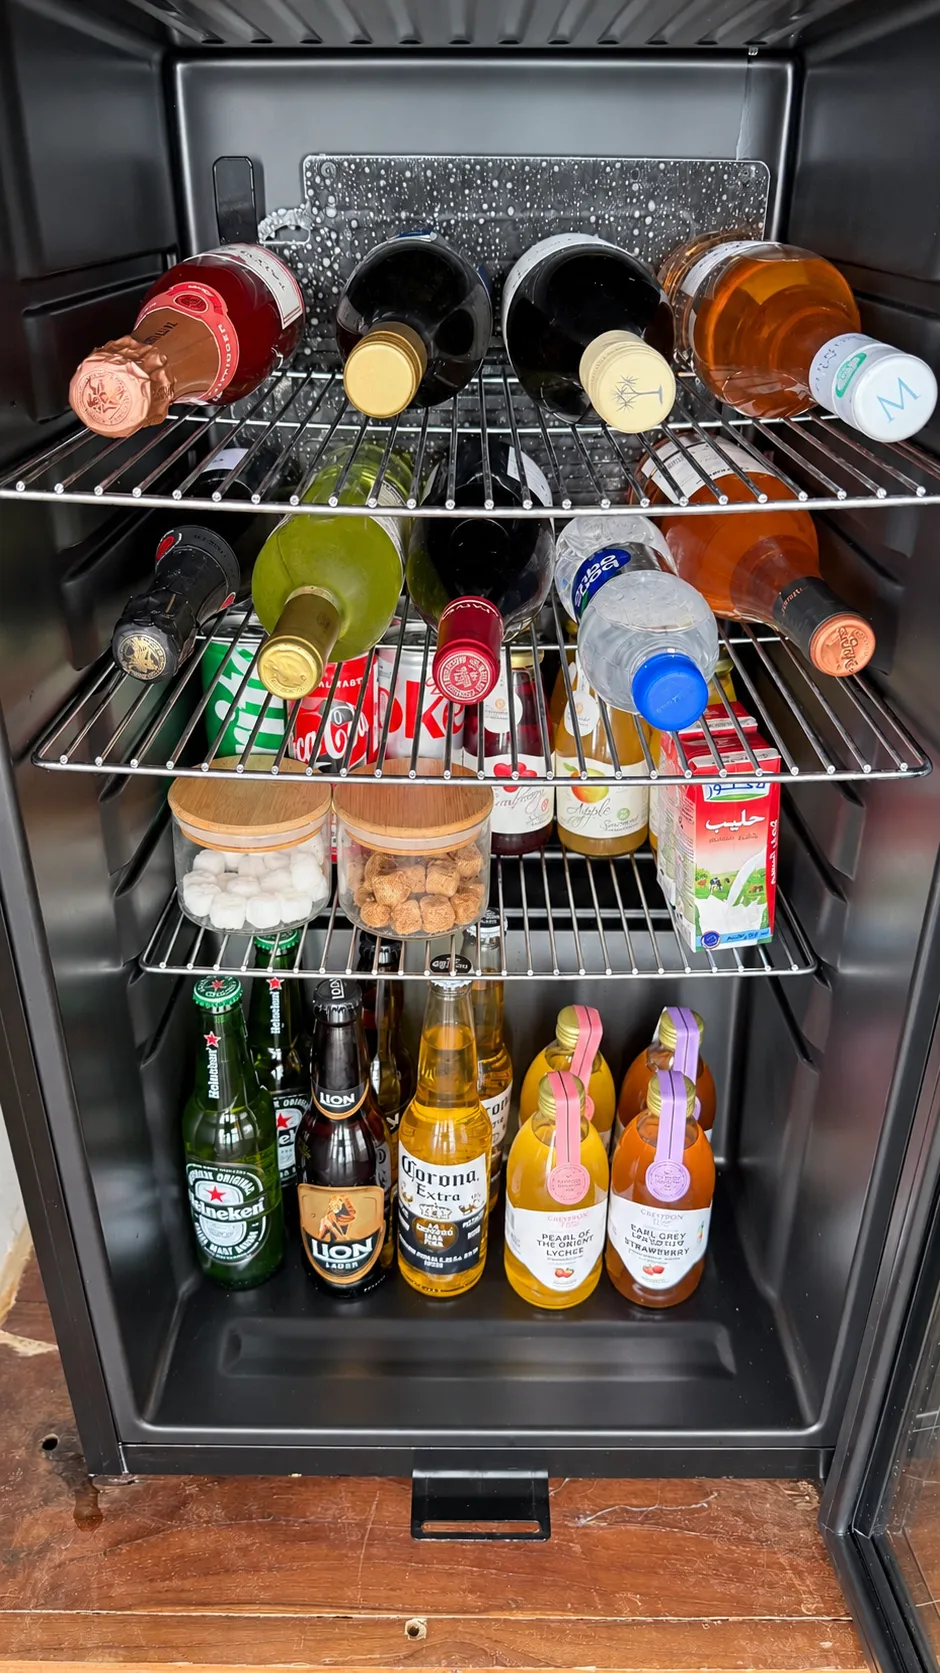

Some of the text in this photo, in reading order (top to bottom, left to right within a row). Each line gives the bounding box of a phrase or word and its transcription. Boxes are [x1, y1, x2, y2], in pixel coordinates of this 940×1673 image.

[565, 798, 611, 829] Apple
[705, 808, 766, 834] حليب
[320, 1091, 355, 1107] LION
[402, 1155, 477, 1187] Corona
[416, 1182, 460, 1202] Extra
[578, 1228, 591, 1238] OF
[311, 1236, 373, 1263] LION
[537, 1239, 556, 1248] THE
[546, 1247, 584, 1257] LYCHEE
